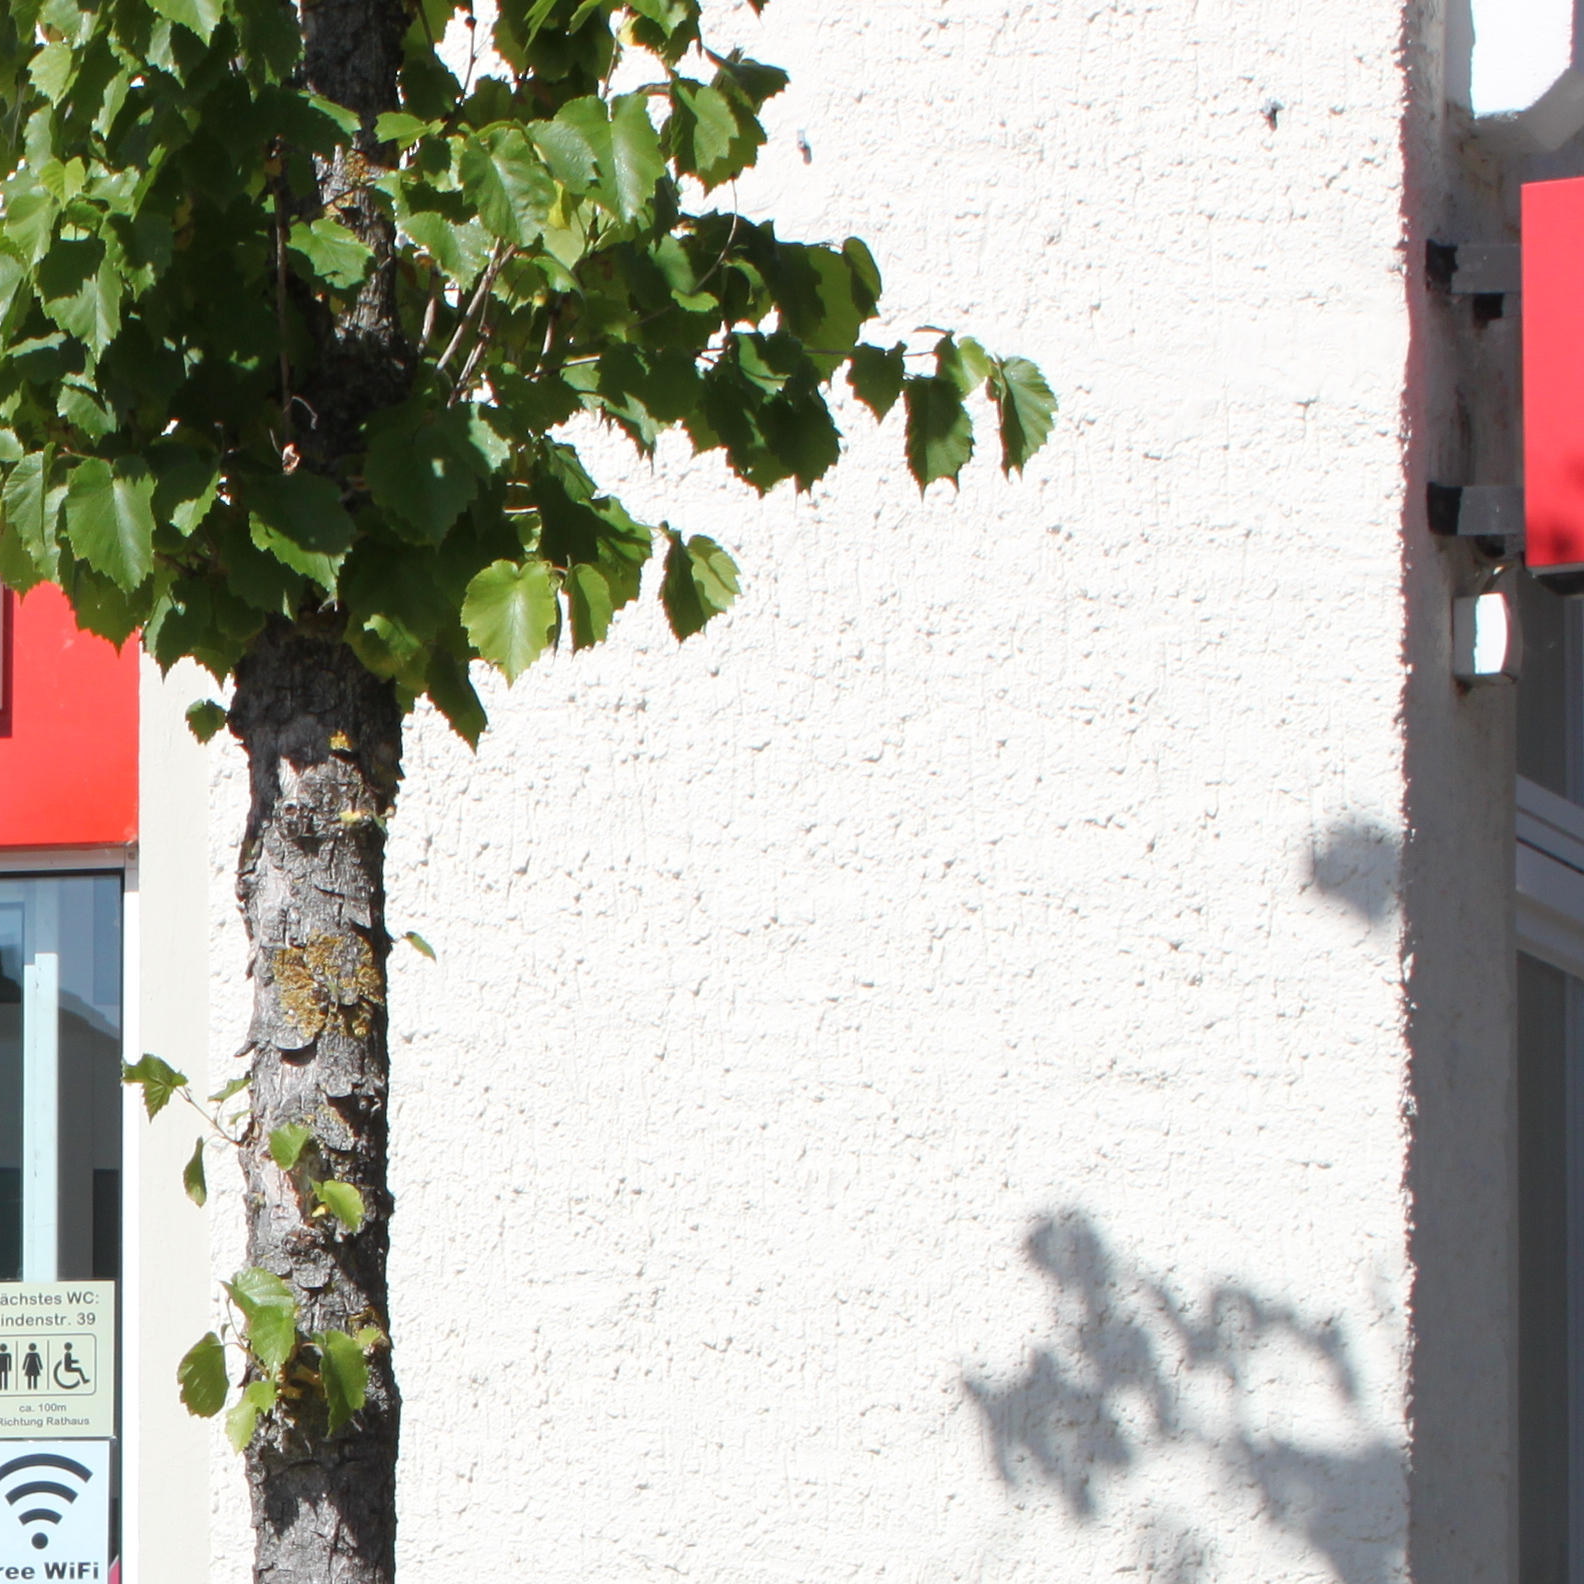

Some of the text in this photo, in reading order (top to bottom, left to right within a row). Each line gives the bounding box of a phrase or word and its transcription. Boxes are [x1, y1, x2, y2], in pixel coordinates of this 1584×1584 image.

[67, 1291, 99, 1304] WC:
[77, 1313, 95, 1325] 39
[38, 1403, 66, 1412] 100m
[46, 1417, 90, 1426] Rathaus
[44, 1562, 98, 1579] WiFi
